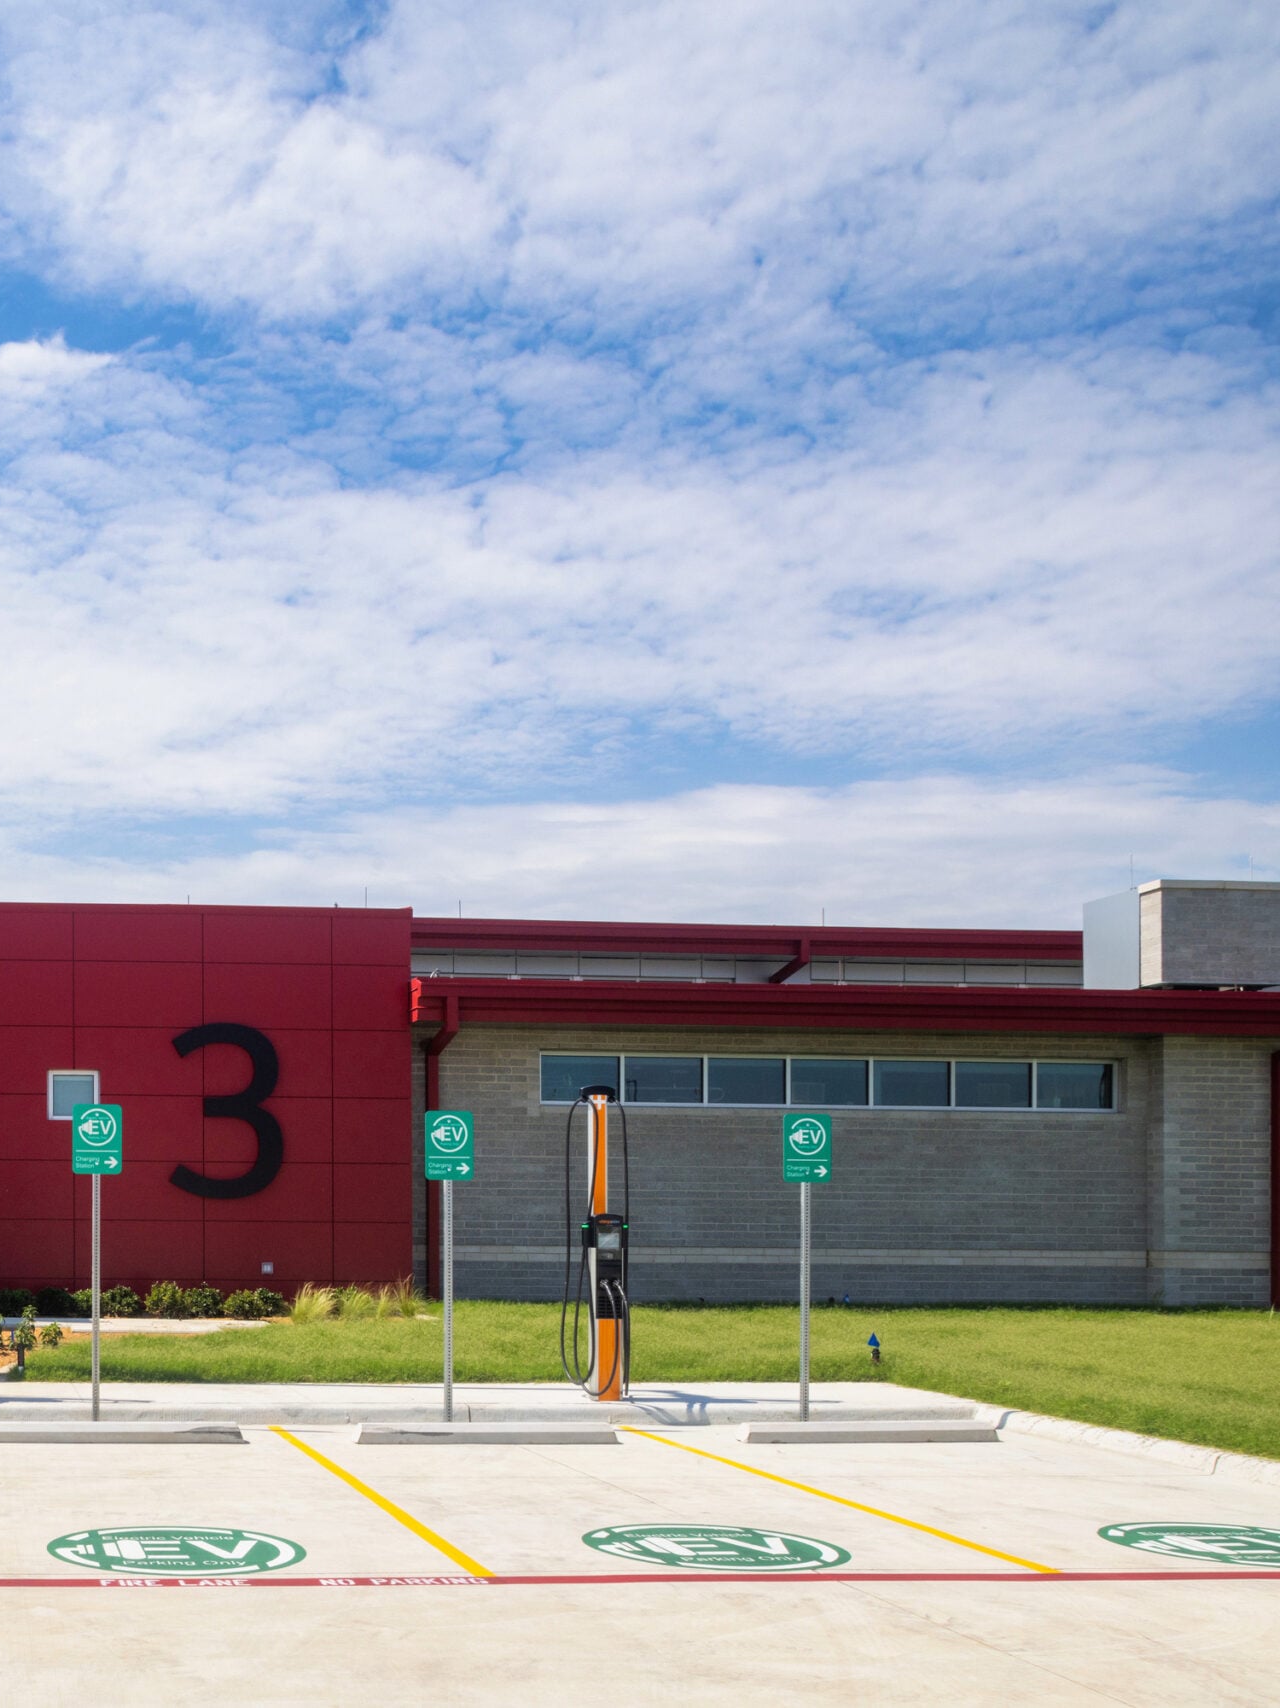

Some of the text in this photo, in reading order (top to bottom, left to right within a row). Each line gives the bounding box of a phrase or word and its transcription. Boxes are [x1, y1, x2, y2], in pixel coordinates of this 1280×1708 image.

[169, 1022, 284, 1200] 3
[87, 1119, 112, 1135] EV
[440, 1126, 464, 1142] EV
[798, 1130, 822, 1144] EV
[114, 1539, 258, 1560] EV
[642, 1536, 790, 1556] EV
[99, 1577, 489, 1587] FIRE LANE NO PARKING
